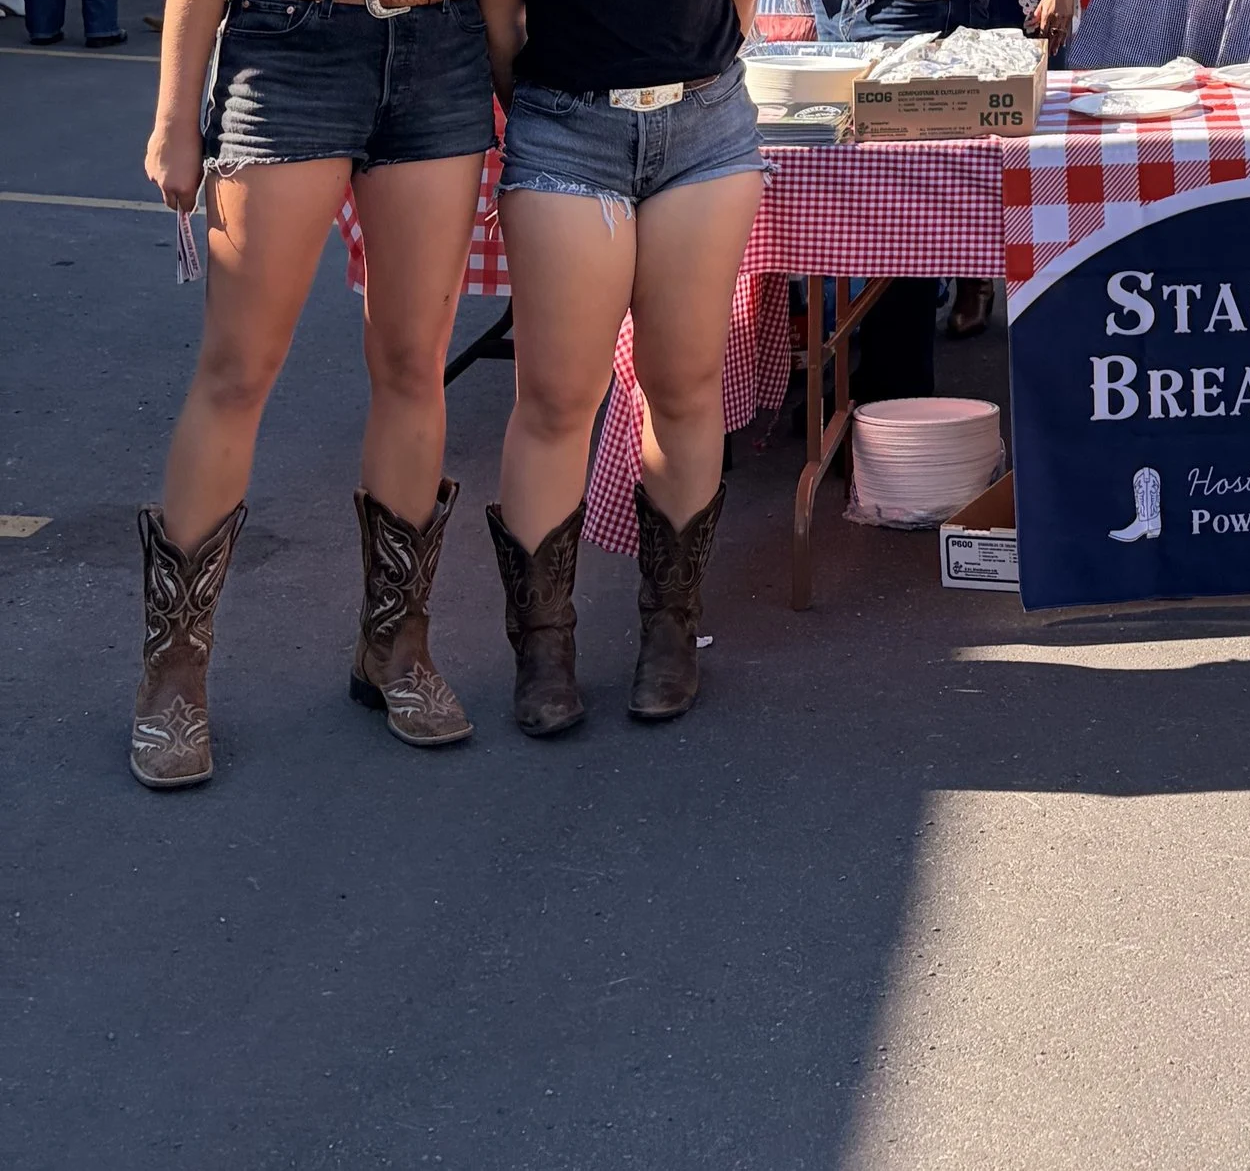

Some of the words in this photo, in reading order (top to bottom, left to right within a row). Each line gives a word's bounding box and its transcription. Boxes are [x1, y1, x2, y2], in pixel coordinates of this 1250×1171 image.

[988, 93, 1014, 109] 80
[979, 112, 1023, 127] KITS
[951, 540, 973, 549] P600
